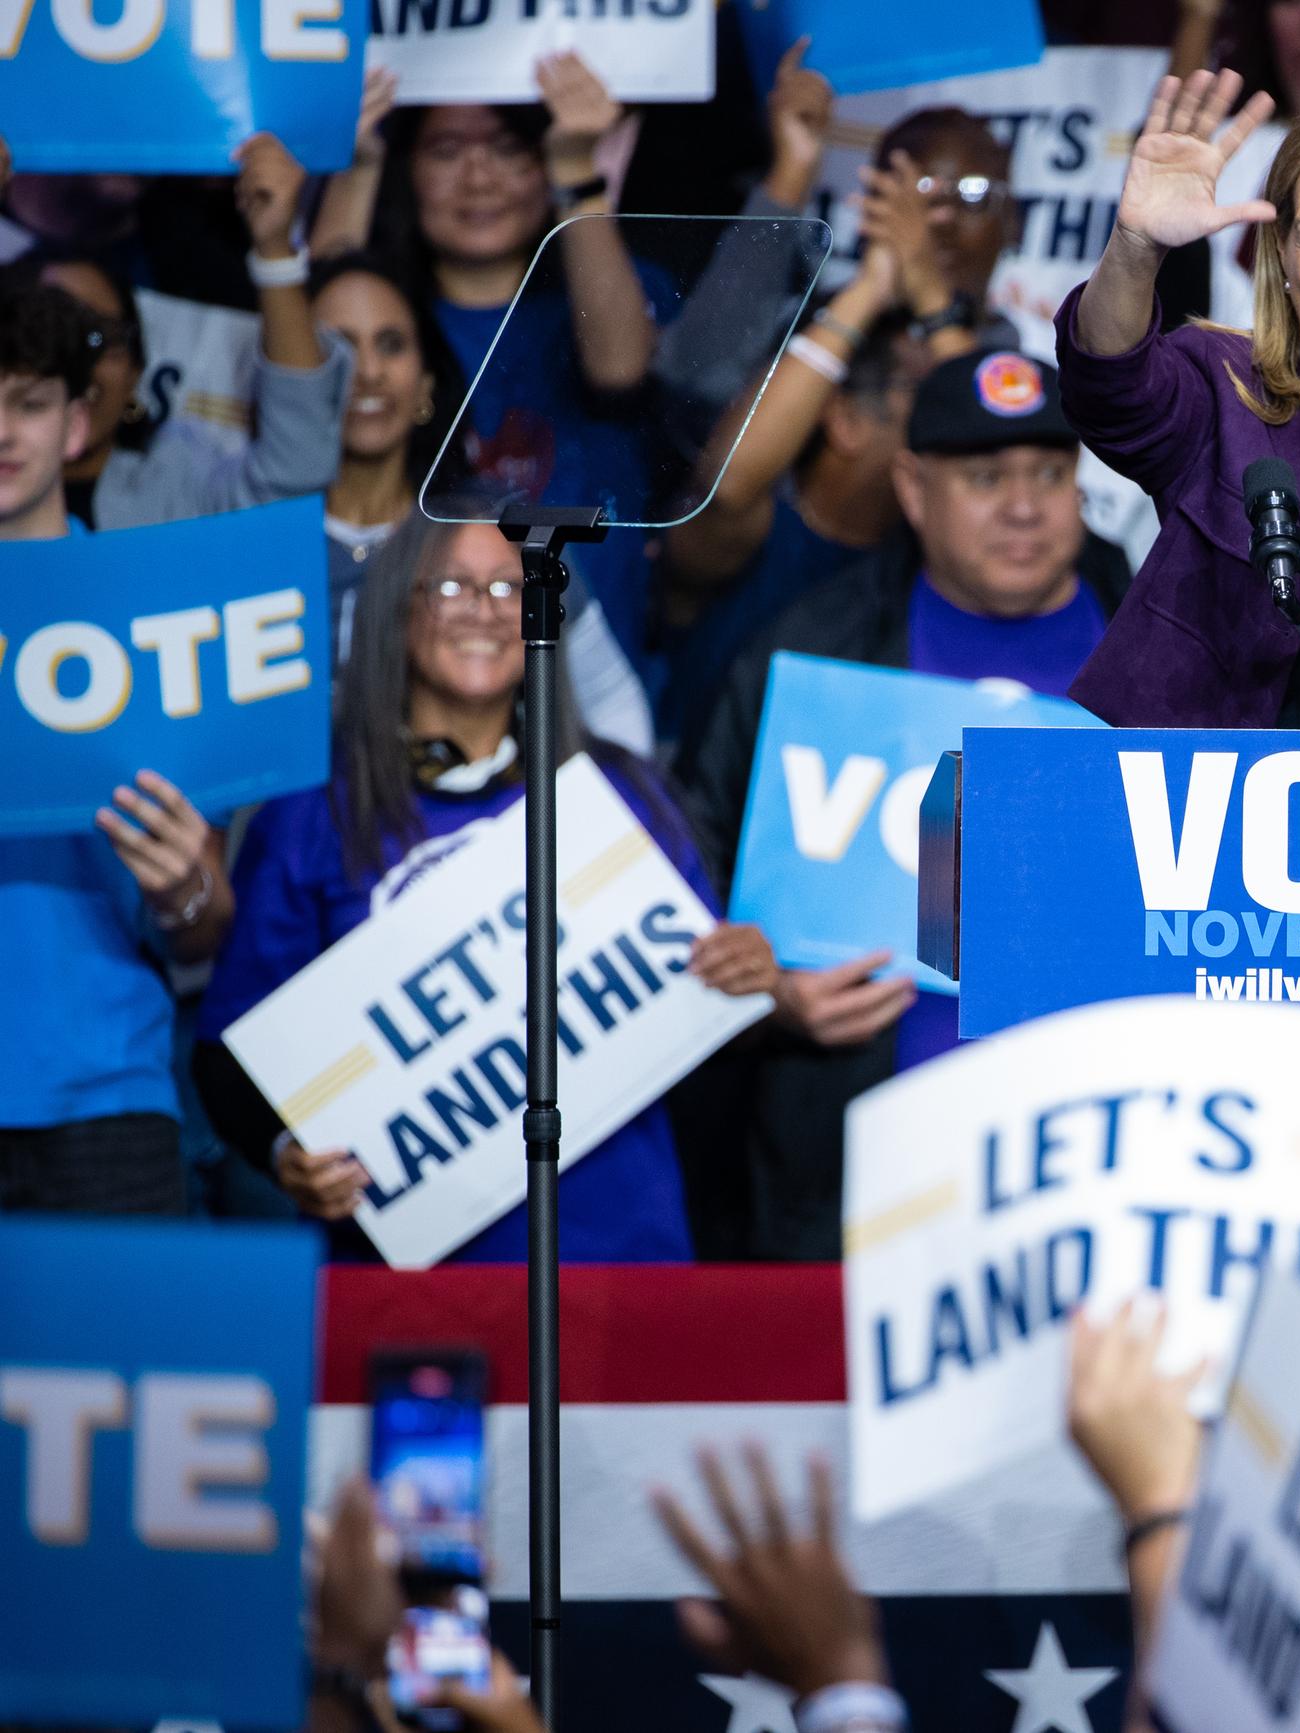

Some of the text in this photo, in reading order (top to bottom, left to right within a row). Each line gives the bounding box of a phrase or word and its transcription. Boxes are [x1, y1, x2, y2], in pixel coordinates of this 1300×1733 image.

[0, 588, 312, 733] OTE
[980, 1088, 1260, 1216] LET'S
[875, 1226, 1094, 1408] LAND
